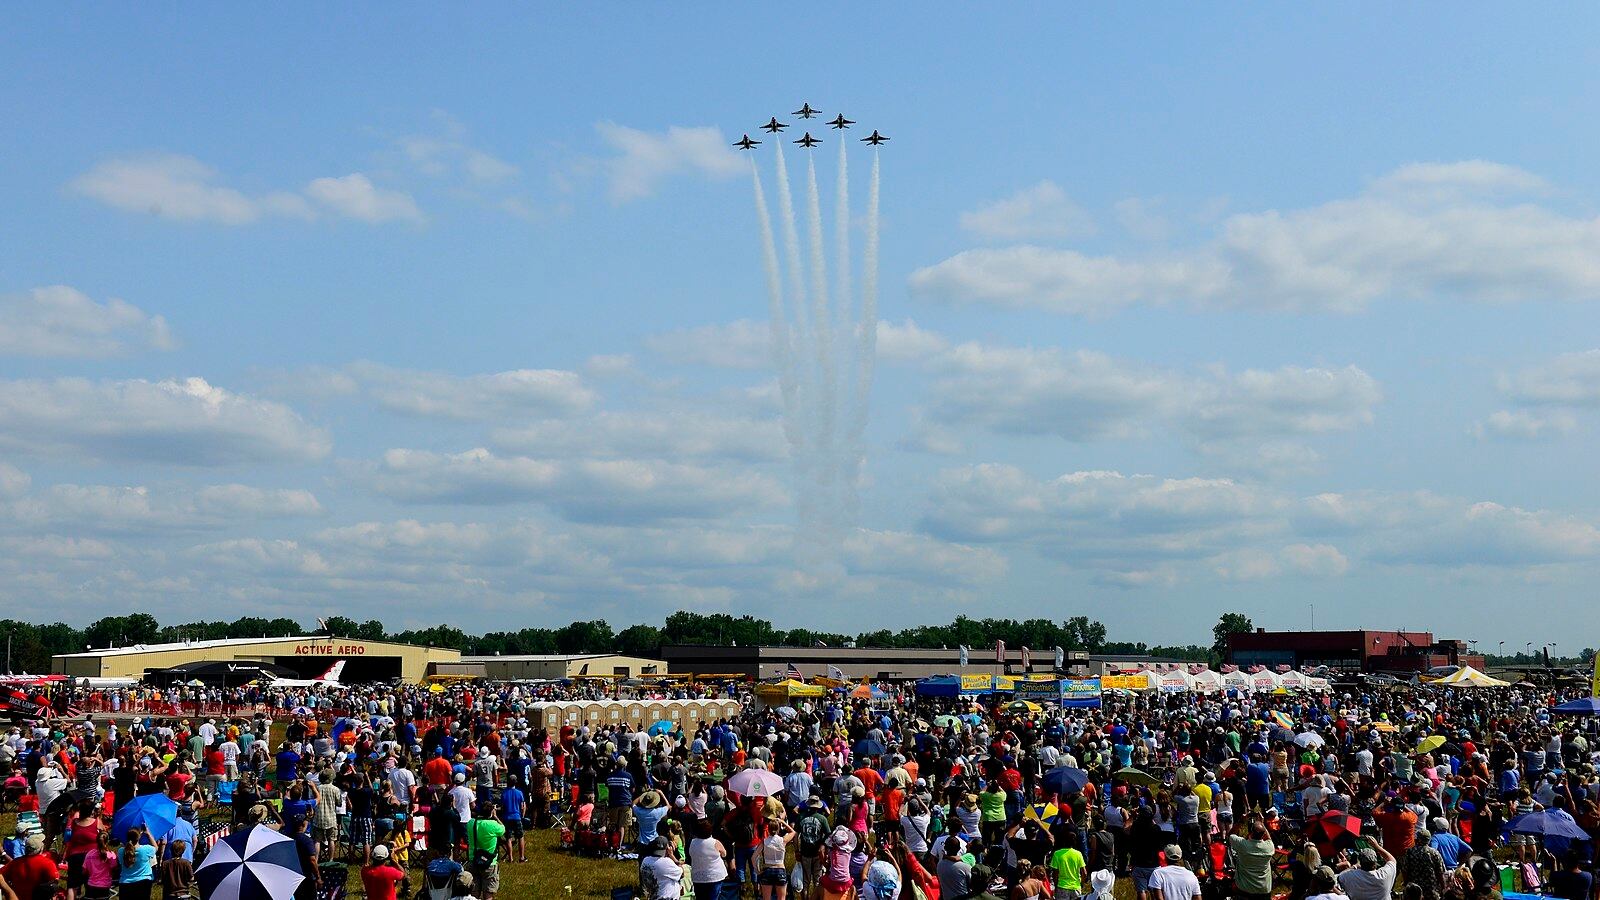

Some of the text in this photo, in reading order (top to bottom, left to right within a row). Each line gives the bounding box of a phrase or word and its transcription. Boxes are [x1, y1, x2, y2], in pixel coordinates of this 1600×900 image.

[295, 645, 365, 655] ACTIVE AERO
[1021, 683, 1055, 692] Smoothies
[1068, 683, 1096, 692] Smoothies
[482, 766, 488, 775] 3
